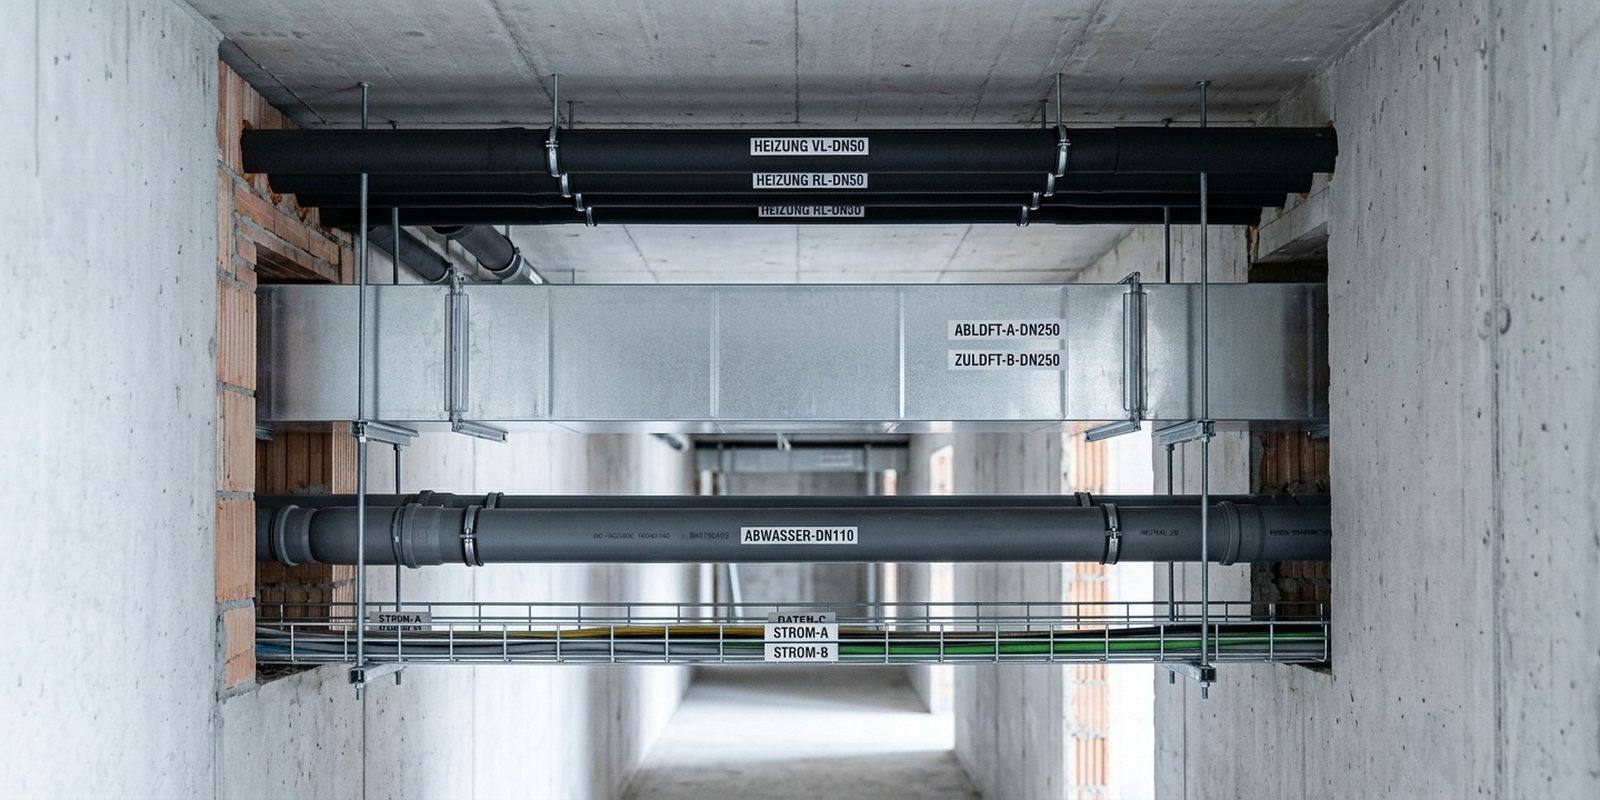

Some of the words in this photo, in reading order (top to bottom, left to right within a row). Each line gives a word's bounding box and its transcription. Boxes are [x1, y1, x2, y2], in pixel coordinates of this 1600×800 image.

[754, 139, 808, 152] HEIZUNG
[756, 174, 808, 186] HEIZUNG
[813, 174, 864, 186] RL-DN50
[761, 206, 809, 216] HEIZUNG
[744, 529, 854, 542] ABWASSER-DN110
[773, 626, 829, 639] STROM-A
